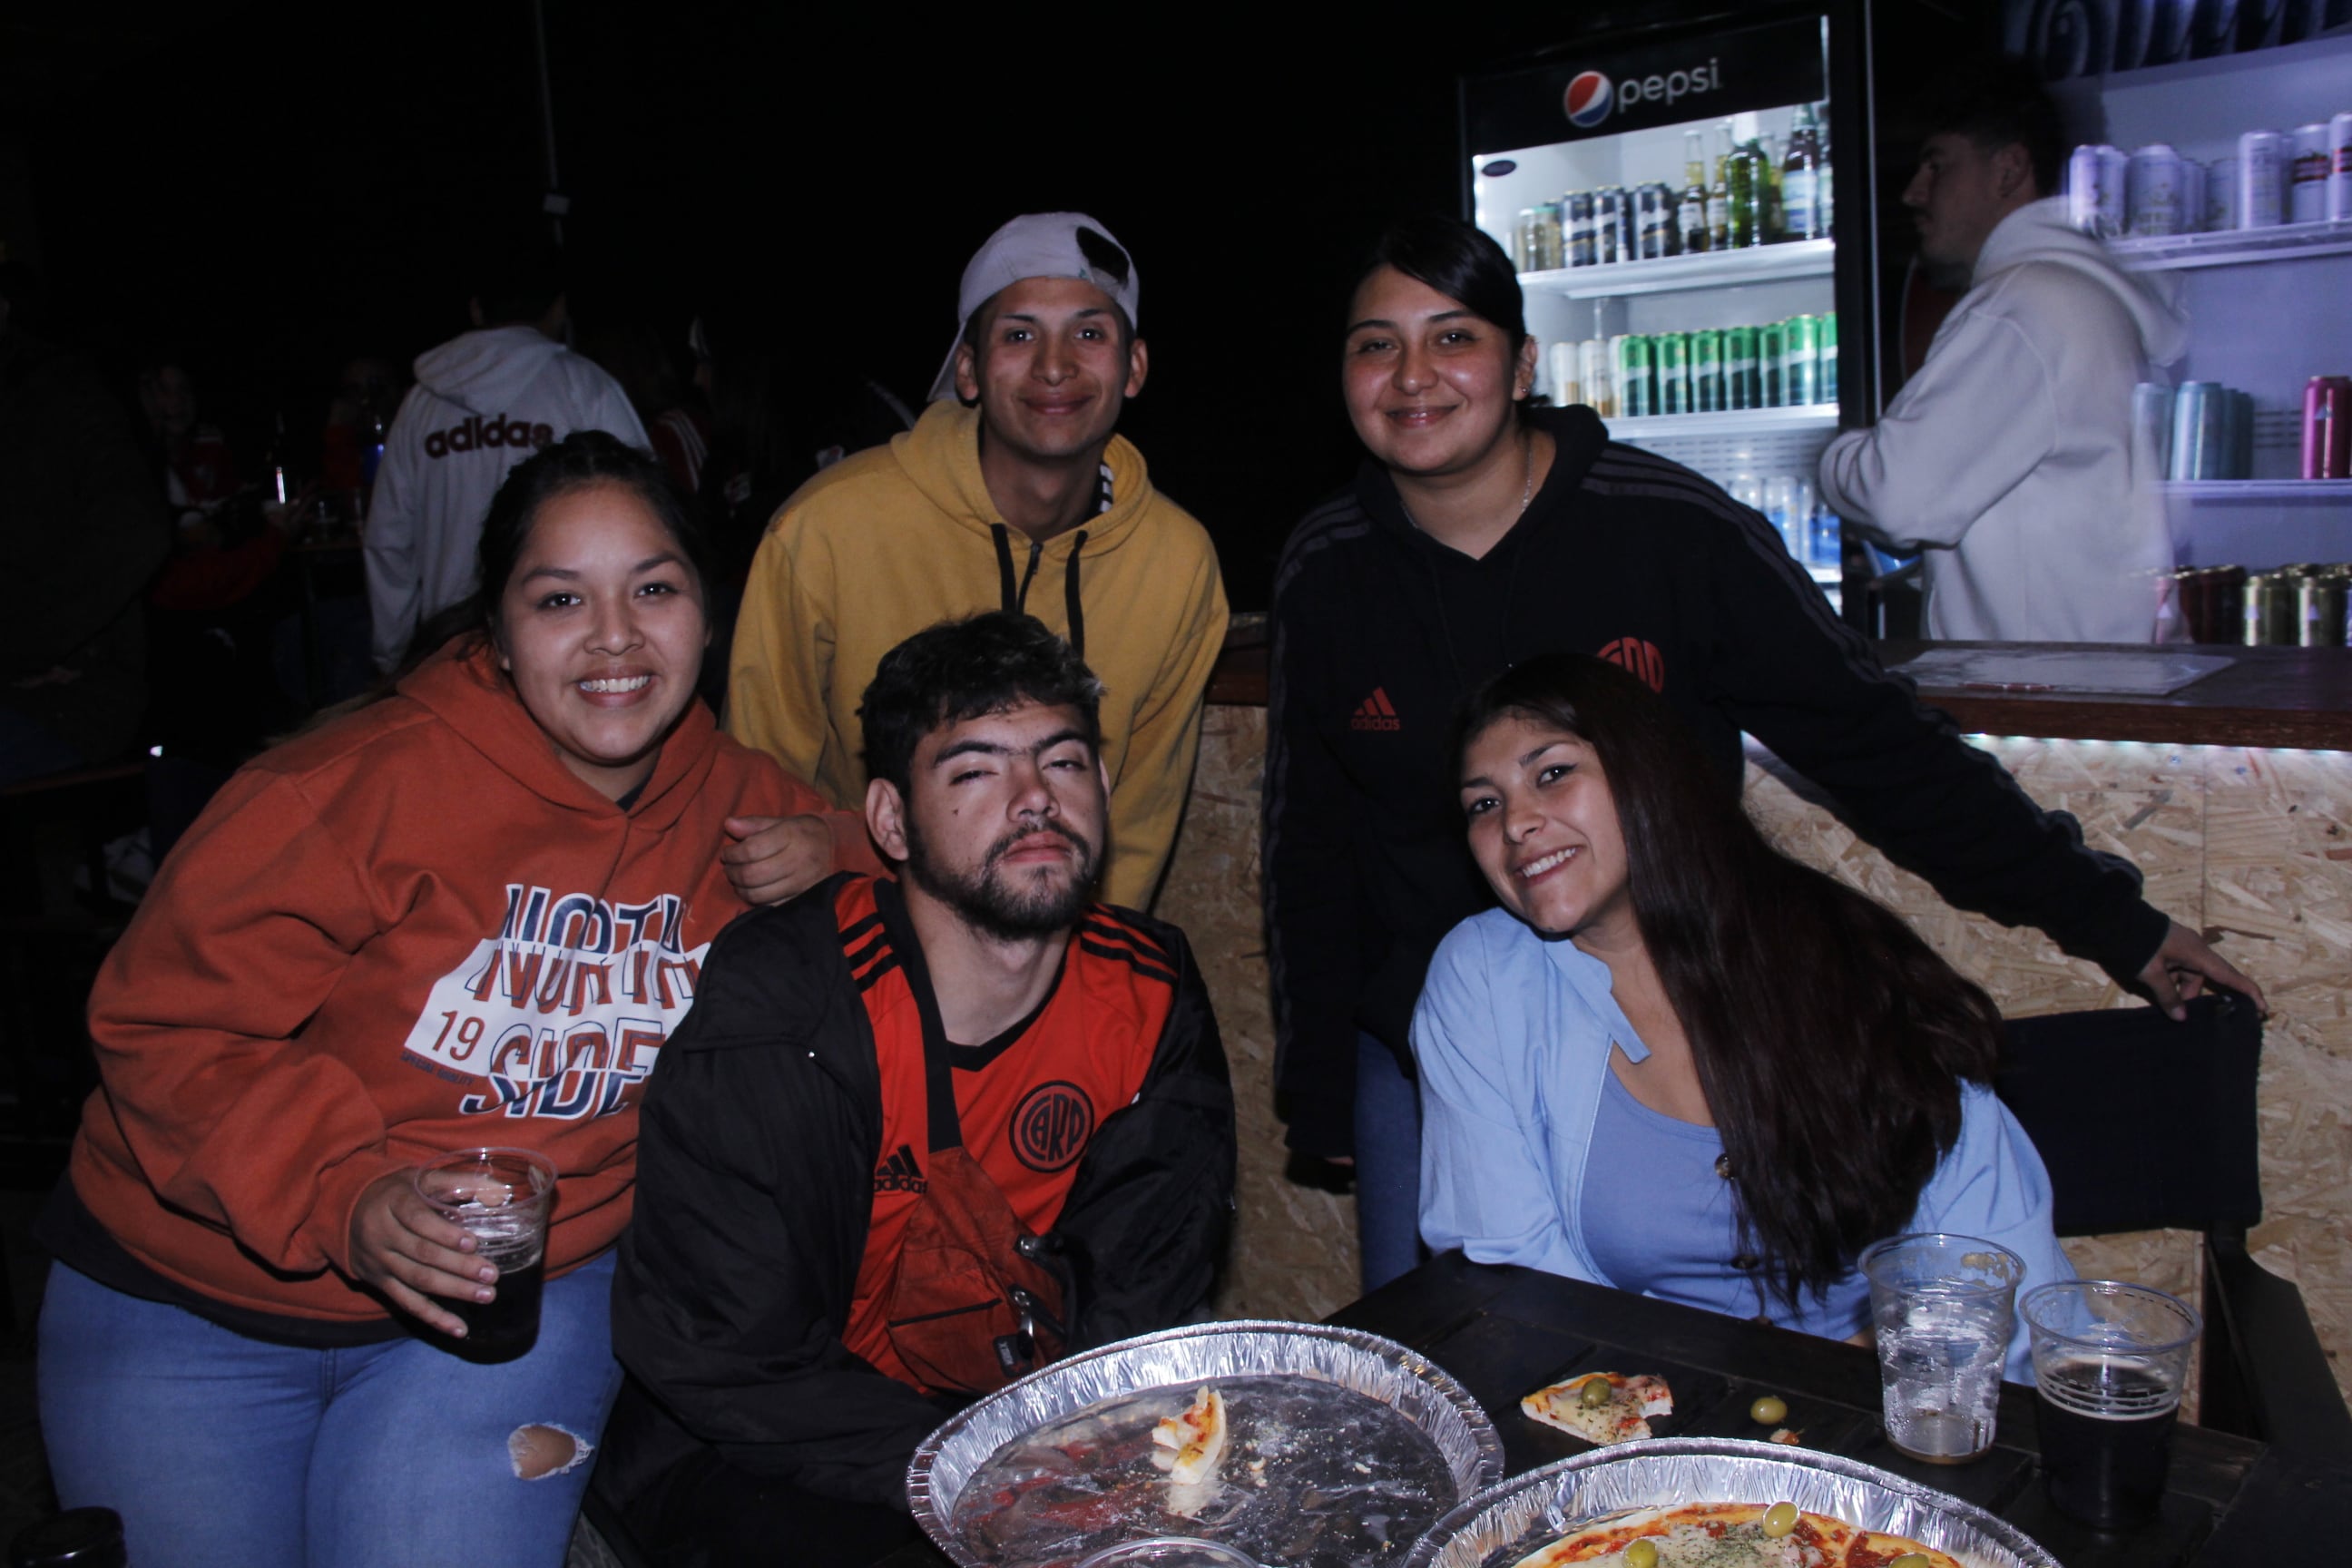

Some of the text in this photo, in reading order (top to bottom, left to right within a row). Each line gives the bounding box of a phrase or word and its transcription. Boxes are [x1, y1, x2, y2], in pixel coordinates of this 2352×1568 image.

[1618, 56, 1721, 114] pepsi
[425, 413, 553, 458] adidas
[1350, 715, 1401, 731] adidas
[432, 1010, 485, 1061] 19
[459, 1017, 668, 1120] SIDE
[1021, 1093, 1085, 1162] CARP
